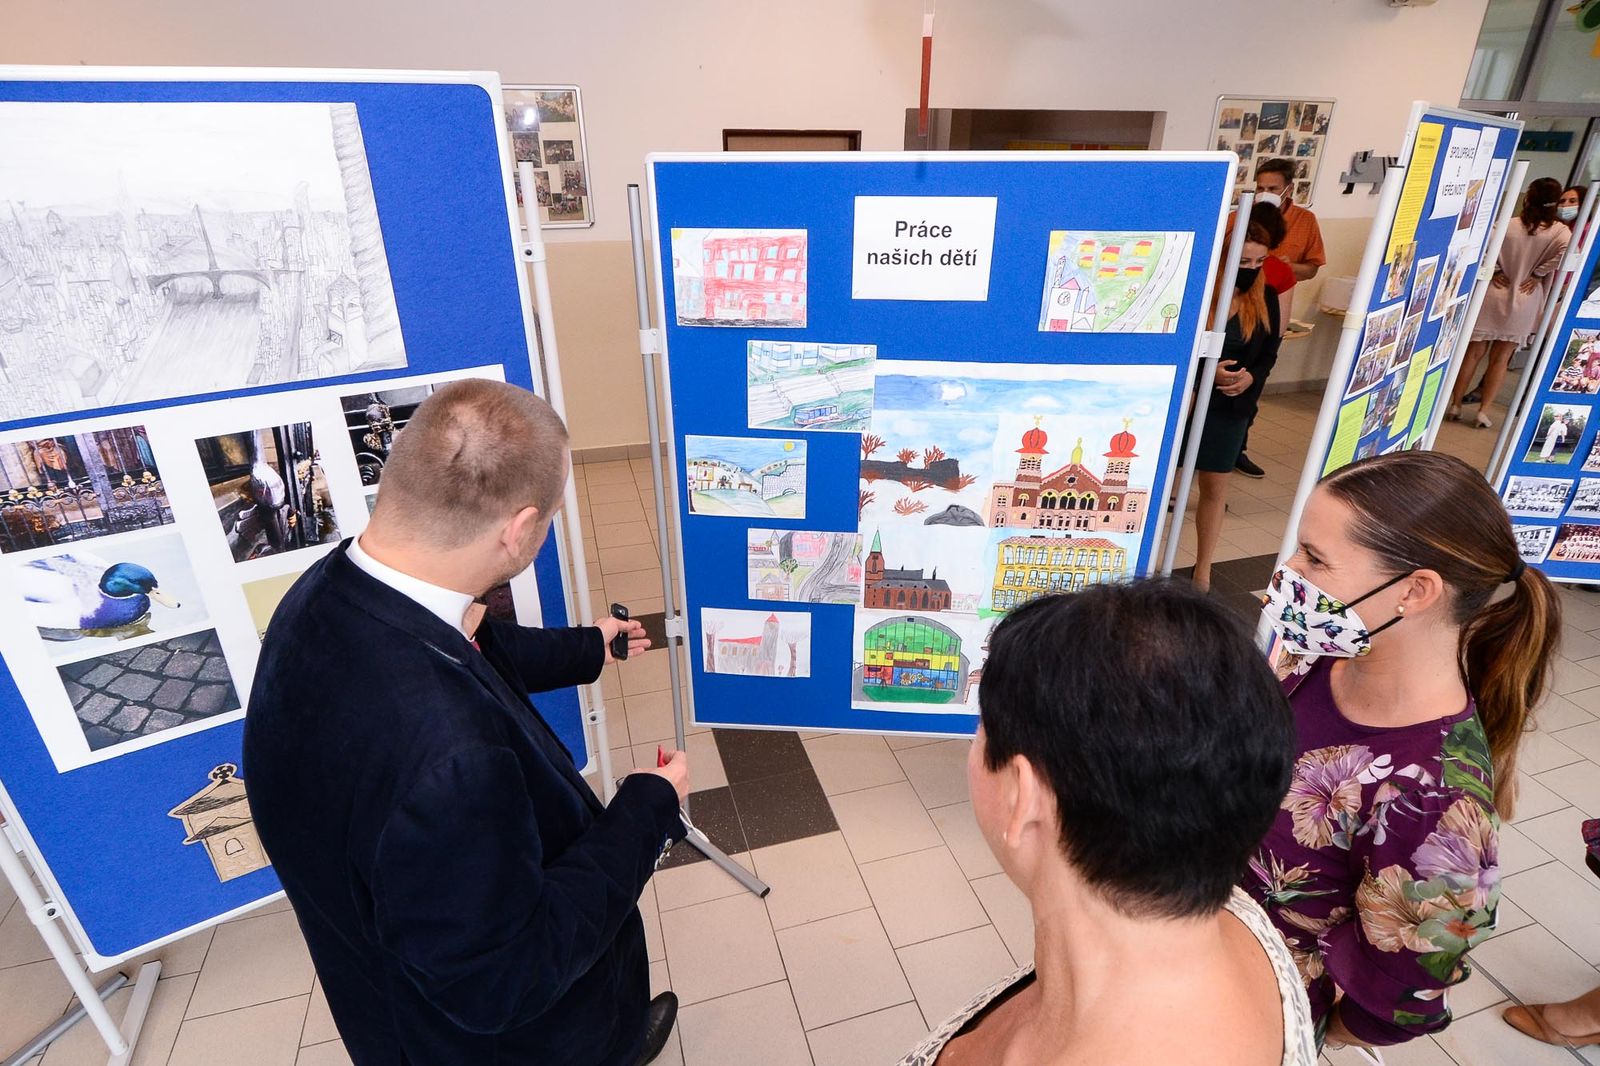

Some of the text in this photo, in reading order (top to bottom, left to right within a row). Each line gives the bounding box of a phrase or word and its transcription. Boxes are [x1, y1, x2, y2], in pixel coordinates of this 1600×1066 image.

[895, 219, 952, 238] Práce
[867, 248, 977, 266] našich dětí
